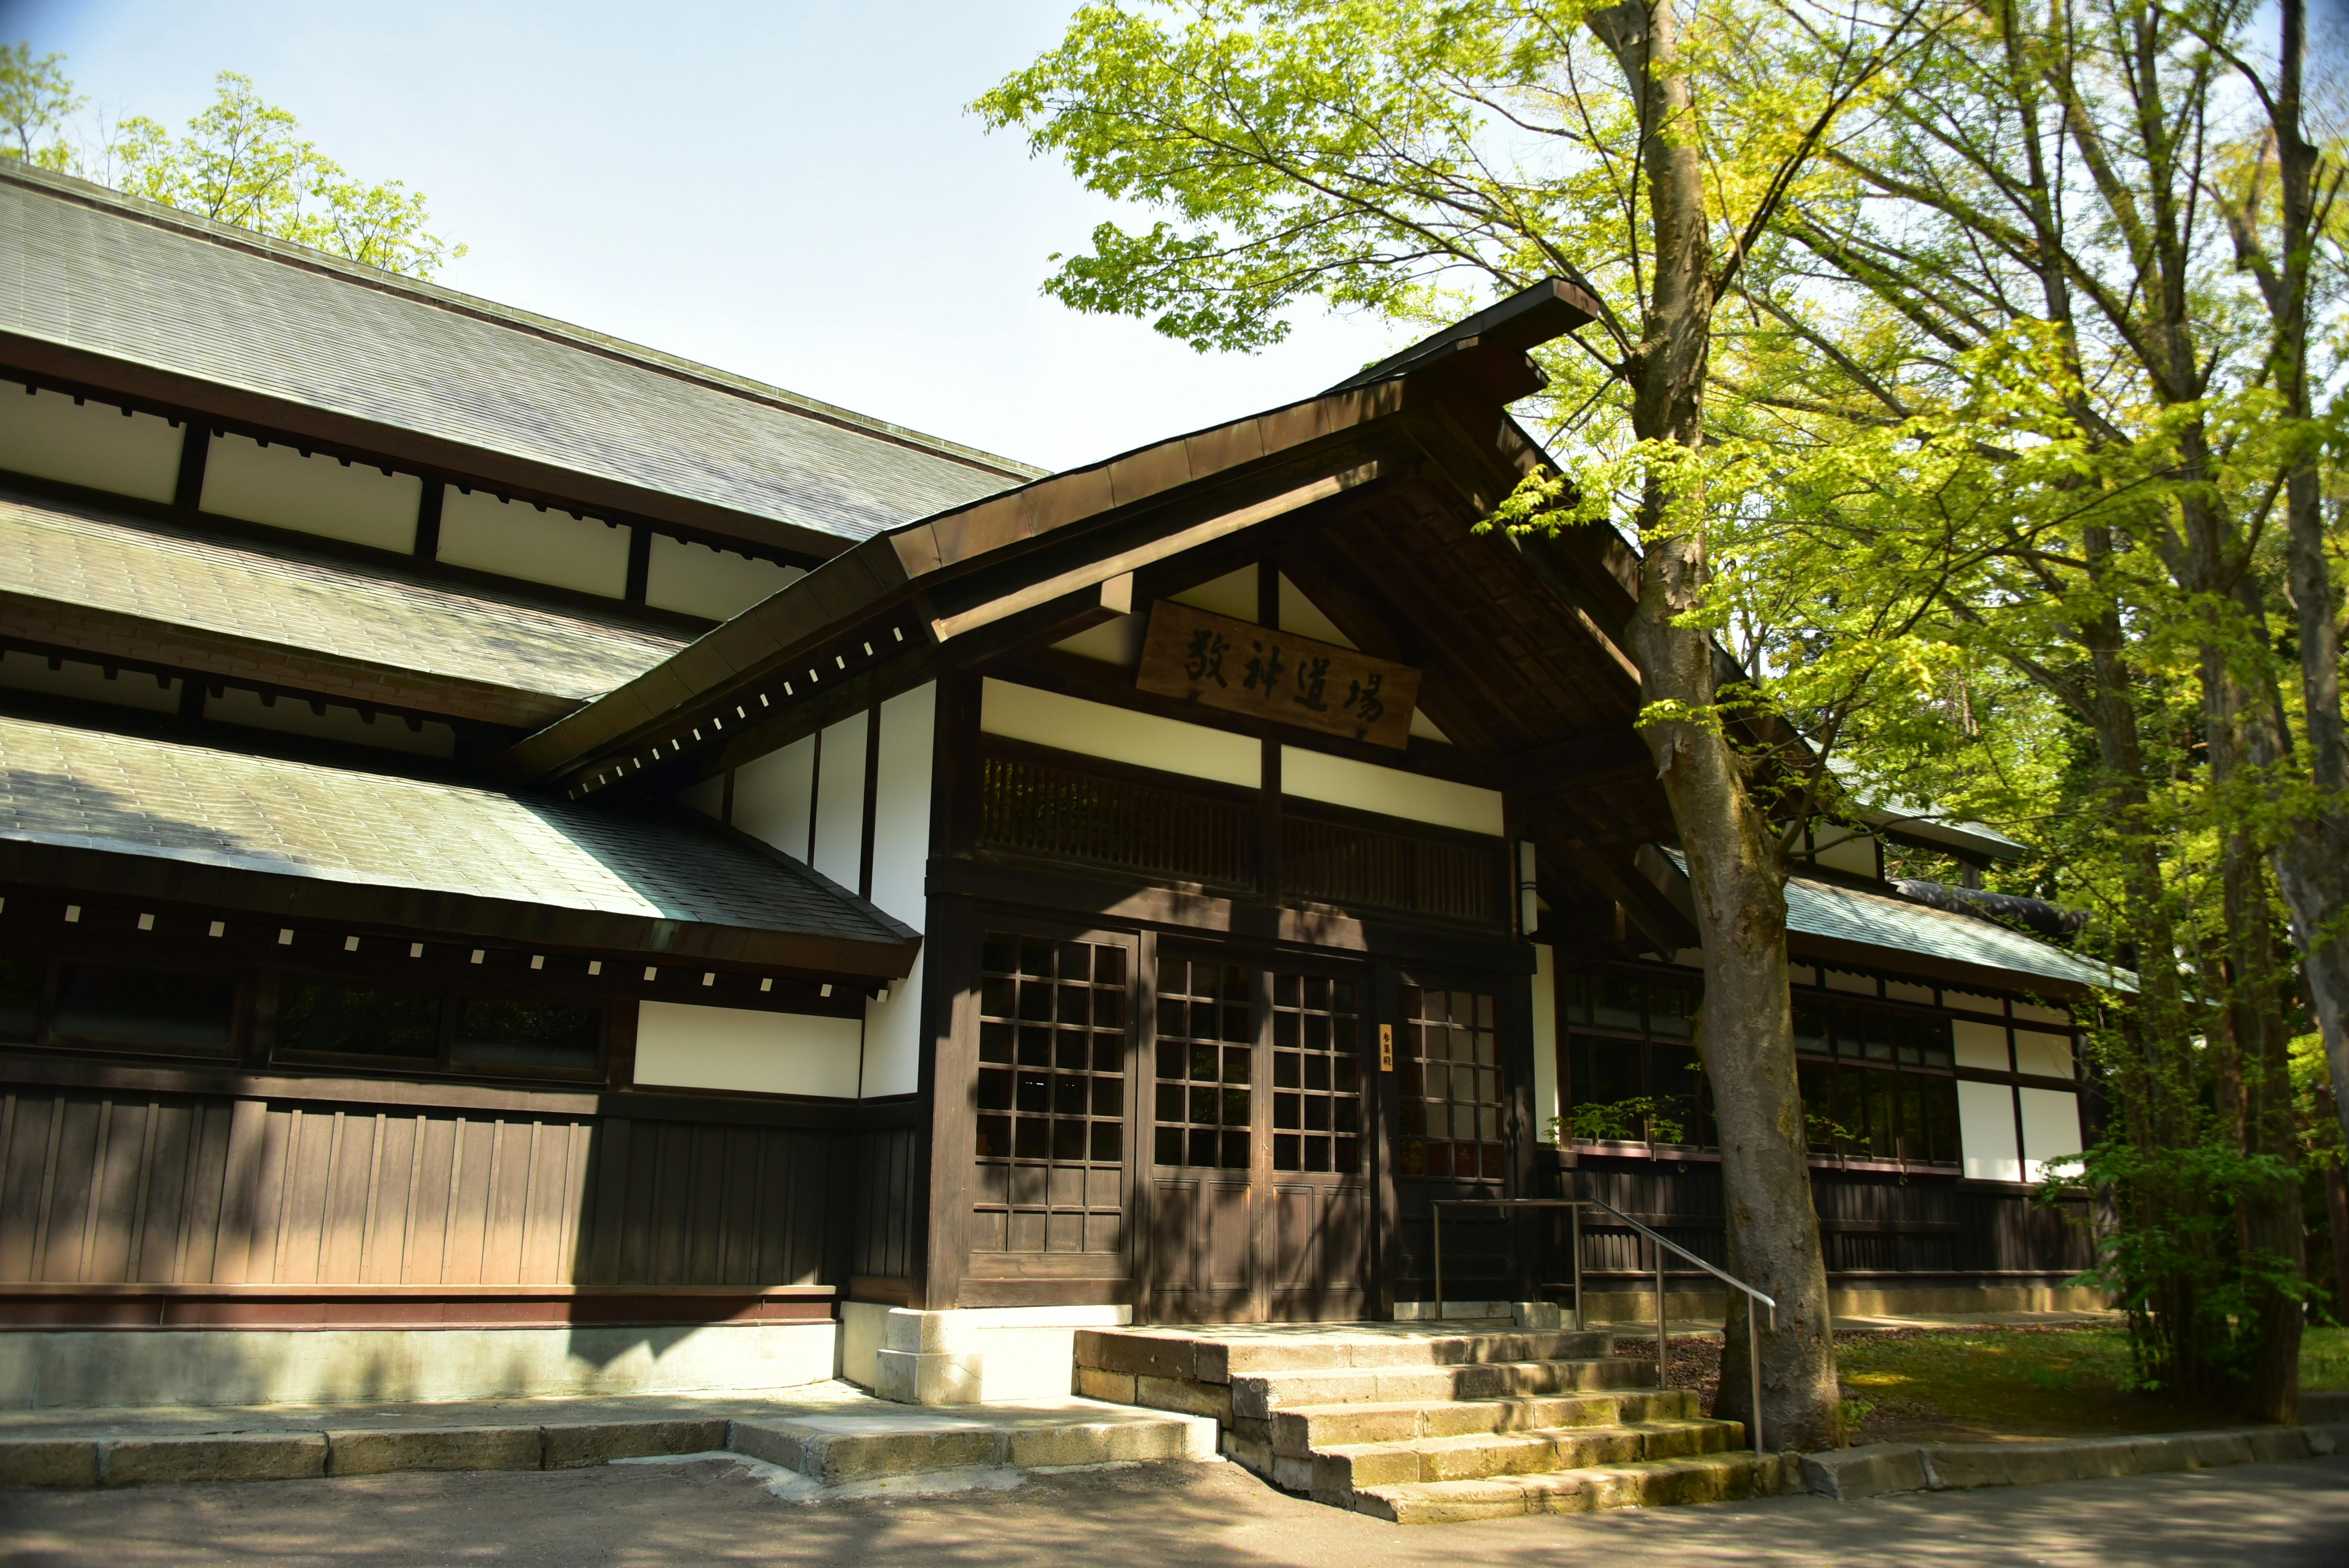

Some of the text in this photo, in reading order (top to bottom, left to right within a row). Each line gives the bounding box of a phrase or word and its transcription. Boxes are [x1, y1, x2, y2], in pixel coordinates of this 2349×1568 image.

[1185, 629, 1384, 722] 敬神道場
[1383, 1032, 1391, 1066] 参集殿
